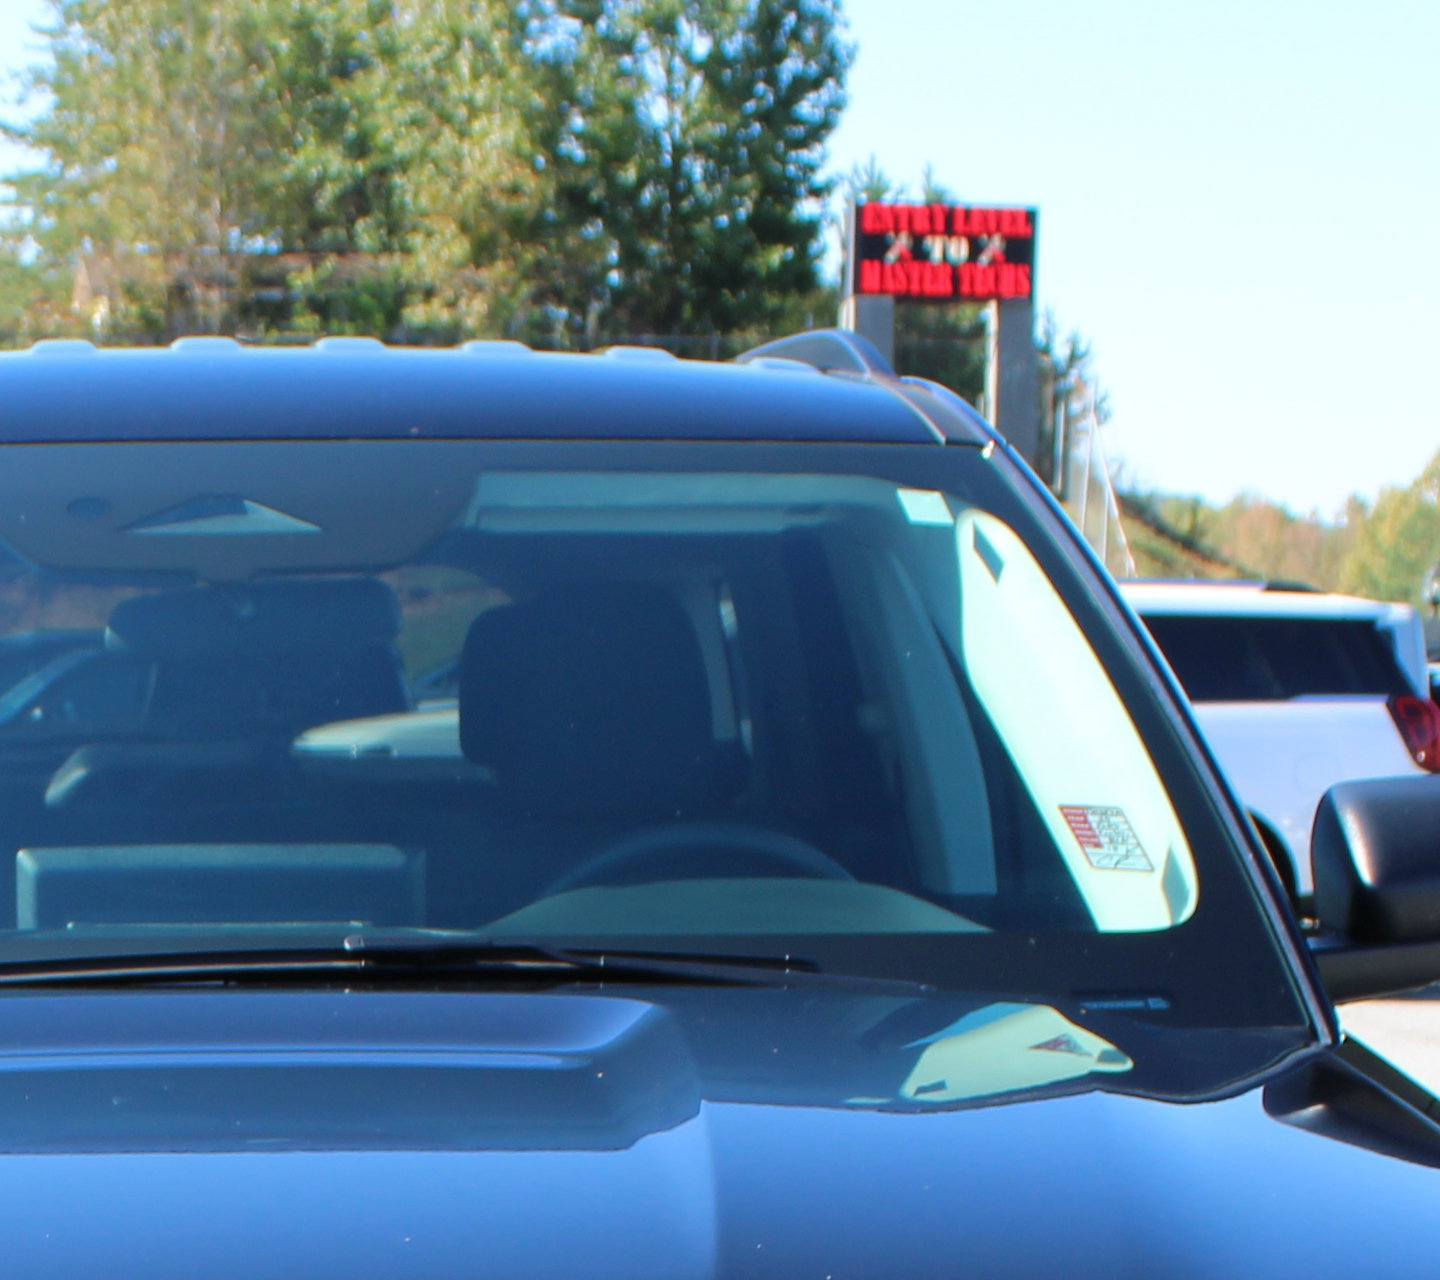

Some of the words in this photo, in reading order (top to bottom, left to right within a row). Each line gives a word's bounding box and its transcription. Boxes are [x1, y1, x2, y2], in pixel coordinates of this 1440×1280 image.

[862, 202, 948, 234] ENTRY
[953, 205, 1033, 238] LEVEL
[922, 233, 970, 266] TO
[860, 259, 953, 296] MASTER
